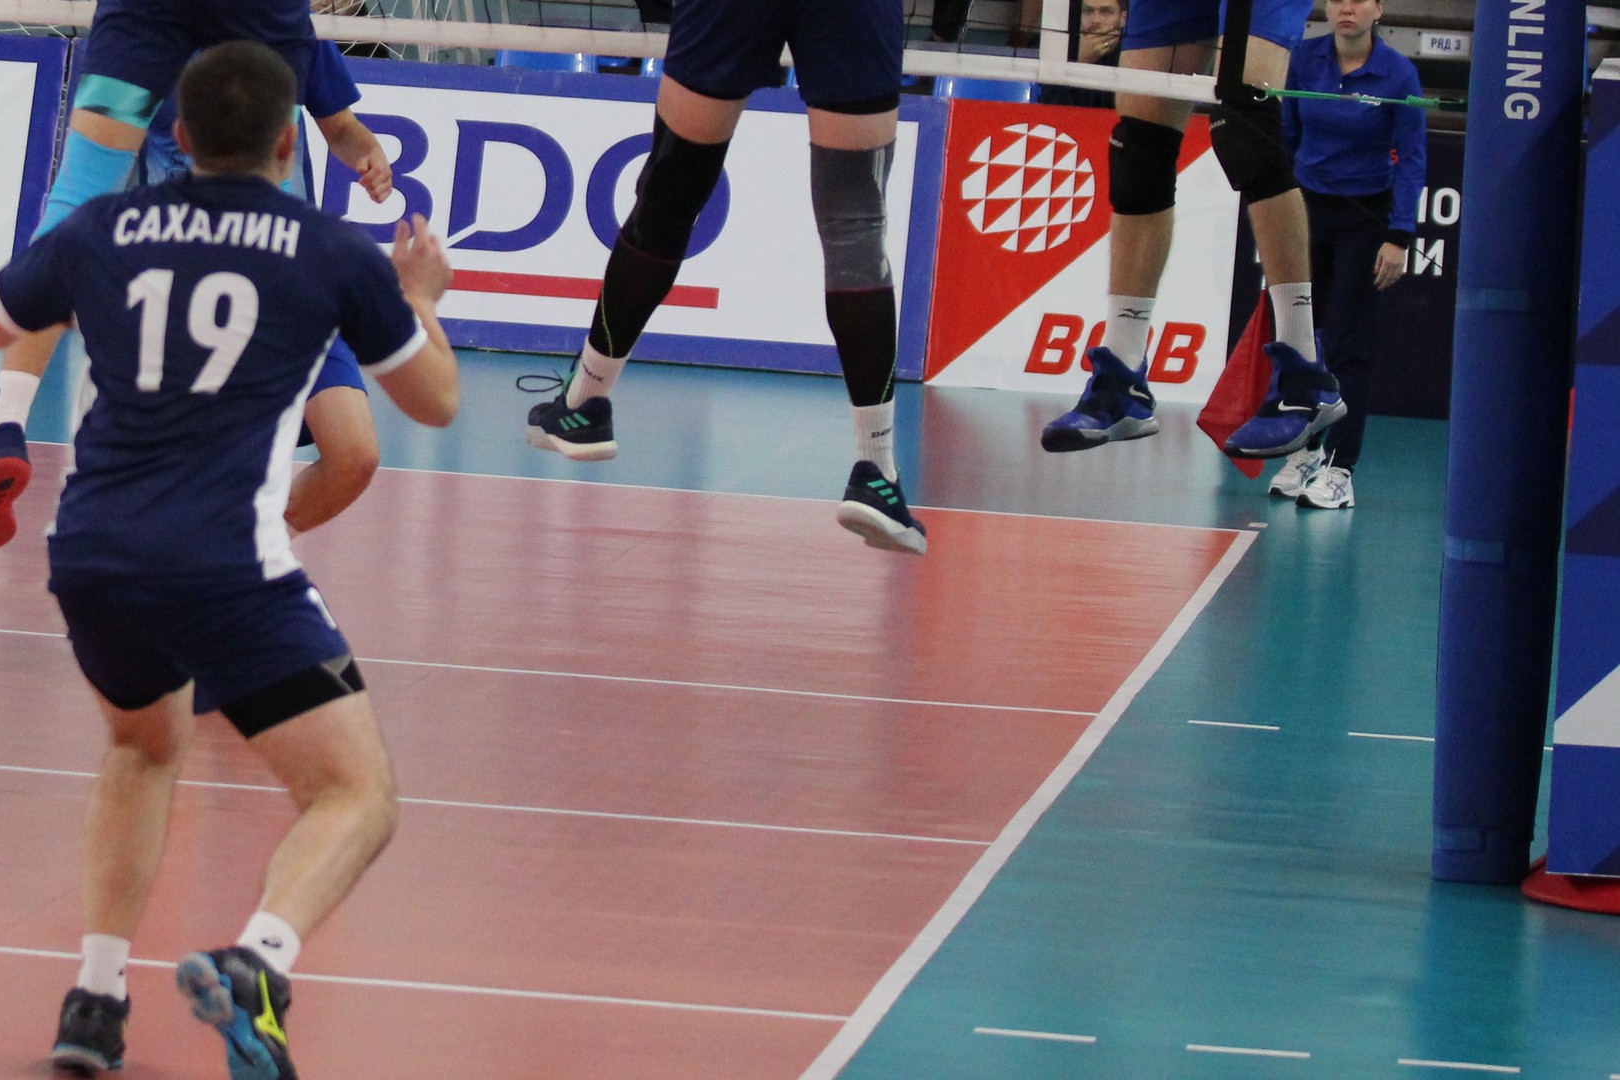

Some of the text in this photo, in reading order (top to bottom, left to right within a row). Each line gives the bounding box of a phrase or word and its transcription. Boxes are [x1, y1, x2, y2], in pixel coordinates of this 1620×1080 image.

[1431, 37, 1461, 51] РЯД 3
[113, 203, 301, 258] САХАЛИН
[321, 112, 730, 261] BDO
[126, 268, 259, 394] 19
